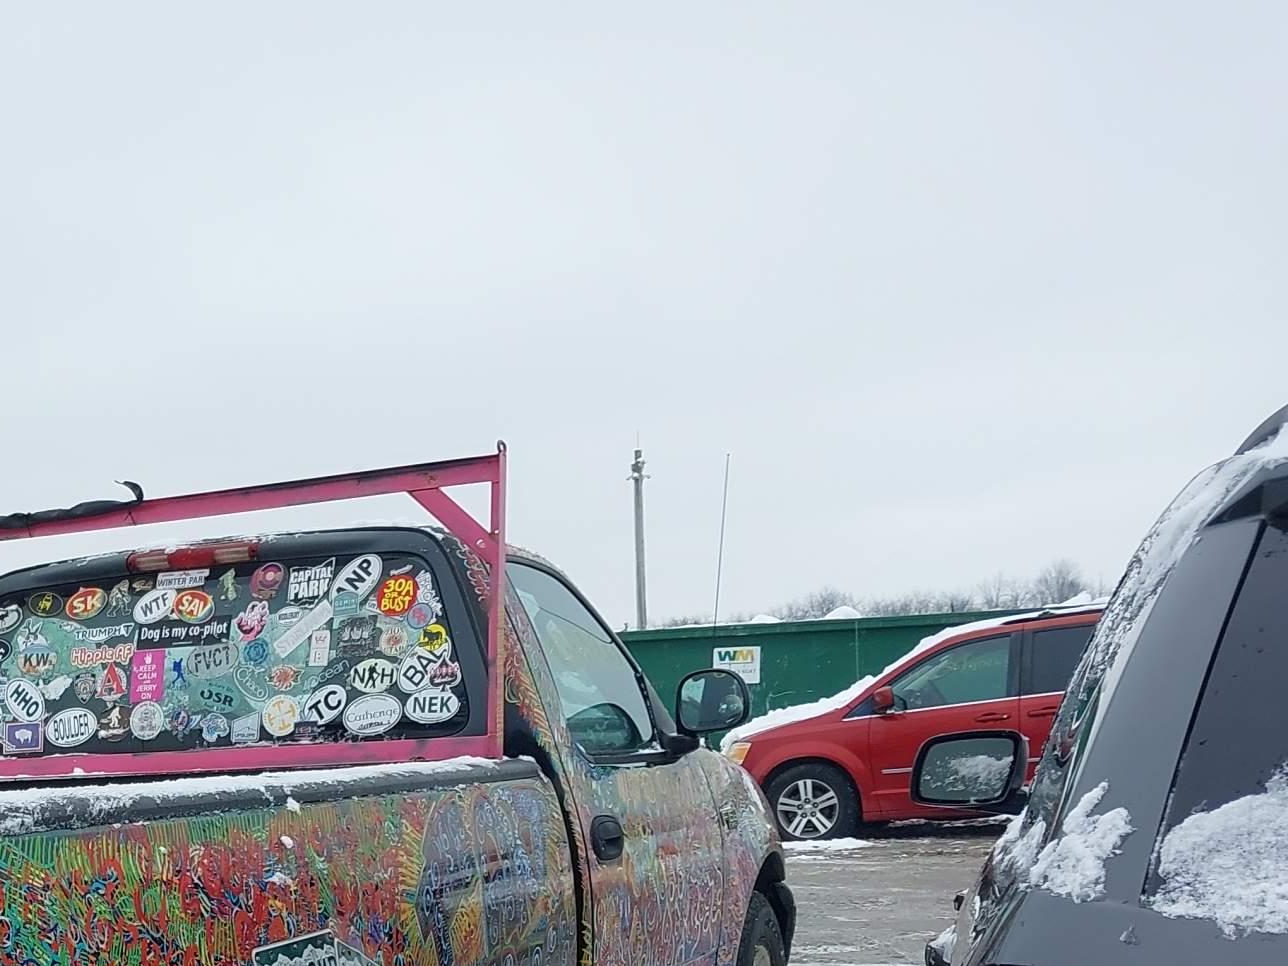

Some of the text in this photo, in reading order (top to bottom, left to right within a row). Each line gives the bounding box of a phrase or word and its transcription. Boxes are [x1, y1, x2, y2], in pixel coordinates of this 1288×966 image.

[157, 575, 187, 587] WINTER
[291, 567, 333, 583] CAPITAL
[290, 578, 331, 600] PARK
[384, 579, 414, 594] 30A
[72, 595, 102, 613] SK
[381, 596, 411, 612] BUST
[384, 592, 398, 600] OR
[140, 593, 170, 618] WTF
[75, 625, 121, 640] TRIUMPH
[141, 621, 228, 641] Dog is my co-pilot
[72, 647, 114, 665] Hippie
[136, 684, 157, 692] JERRY
[236, 666, 265, 697] Chaco
[9, 684, 40, 718] HHO
[308, 690, 343, 721] TC
[413, 696, 452, 714] NEK
[52, 713, 91, 741] BOULDER
